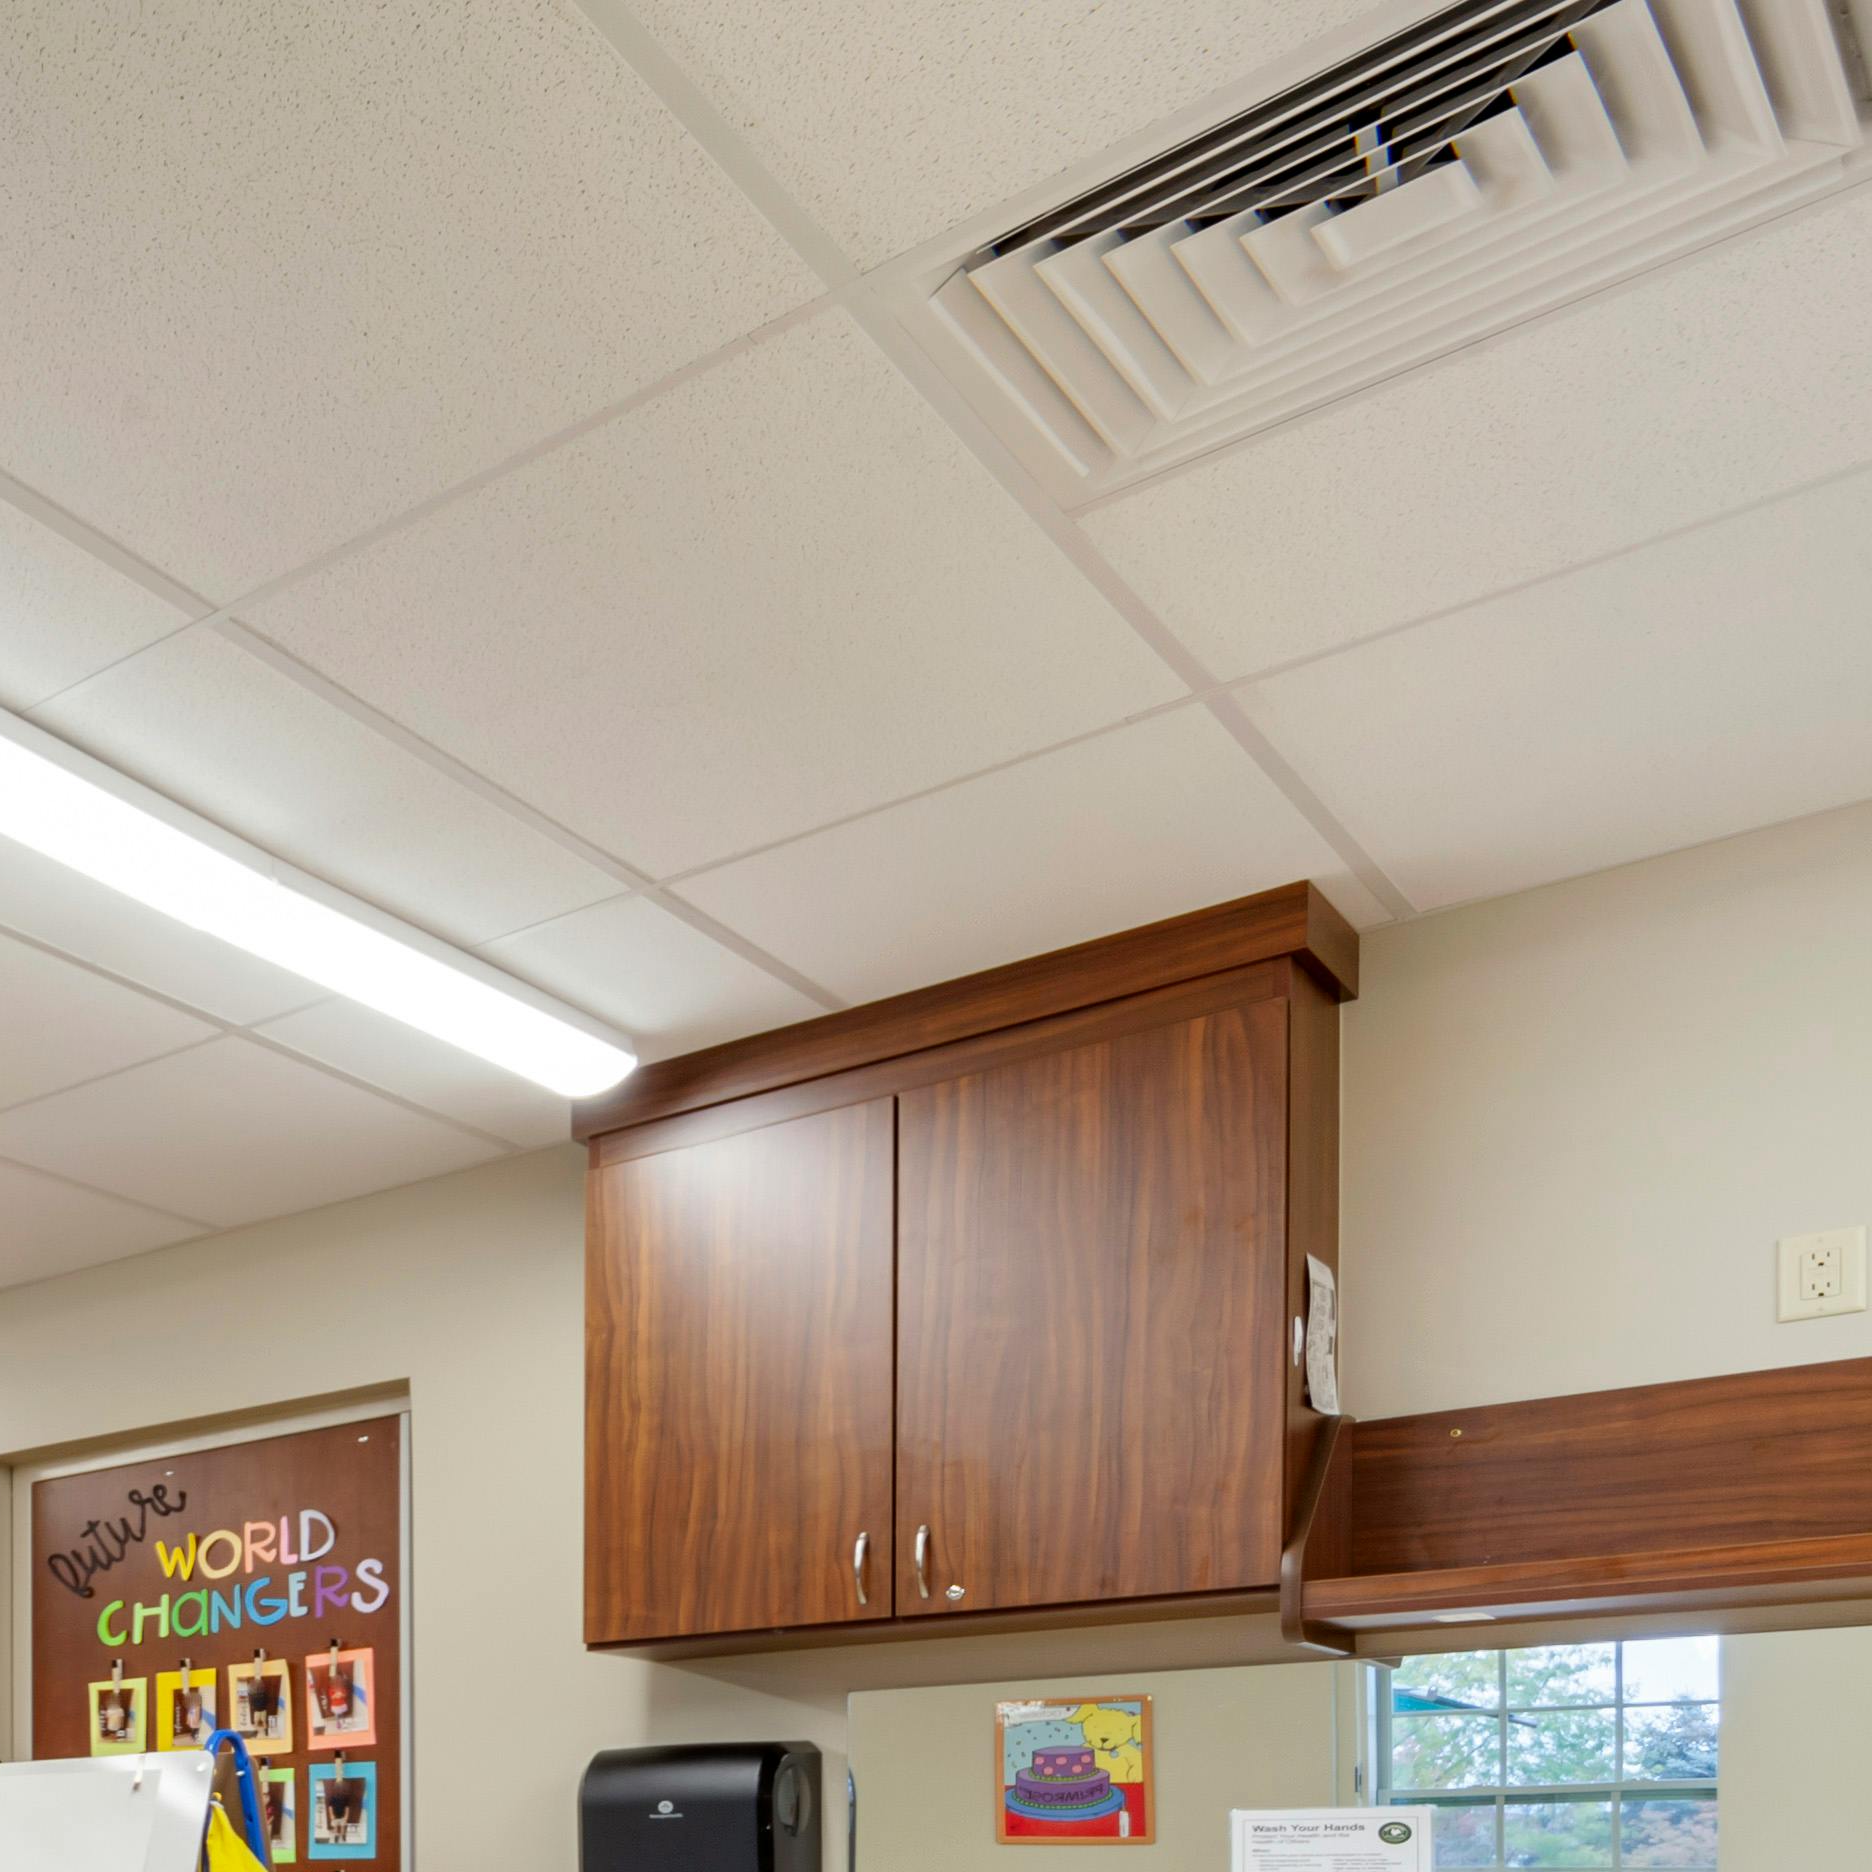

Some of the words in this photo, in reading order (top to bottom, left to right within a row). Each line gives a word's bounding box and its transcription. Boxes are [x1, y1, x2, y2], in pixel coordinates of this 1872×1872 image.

[155, 1509, 336, 1581] WORLD
[1252, 1824, 1287, 1833] Wash
[1291, 1824, 1320, 1832] Your
[1323, 1823, 1365, 1832] Hands
